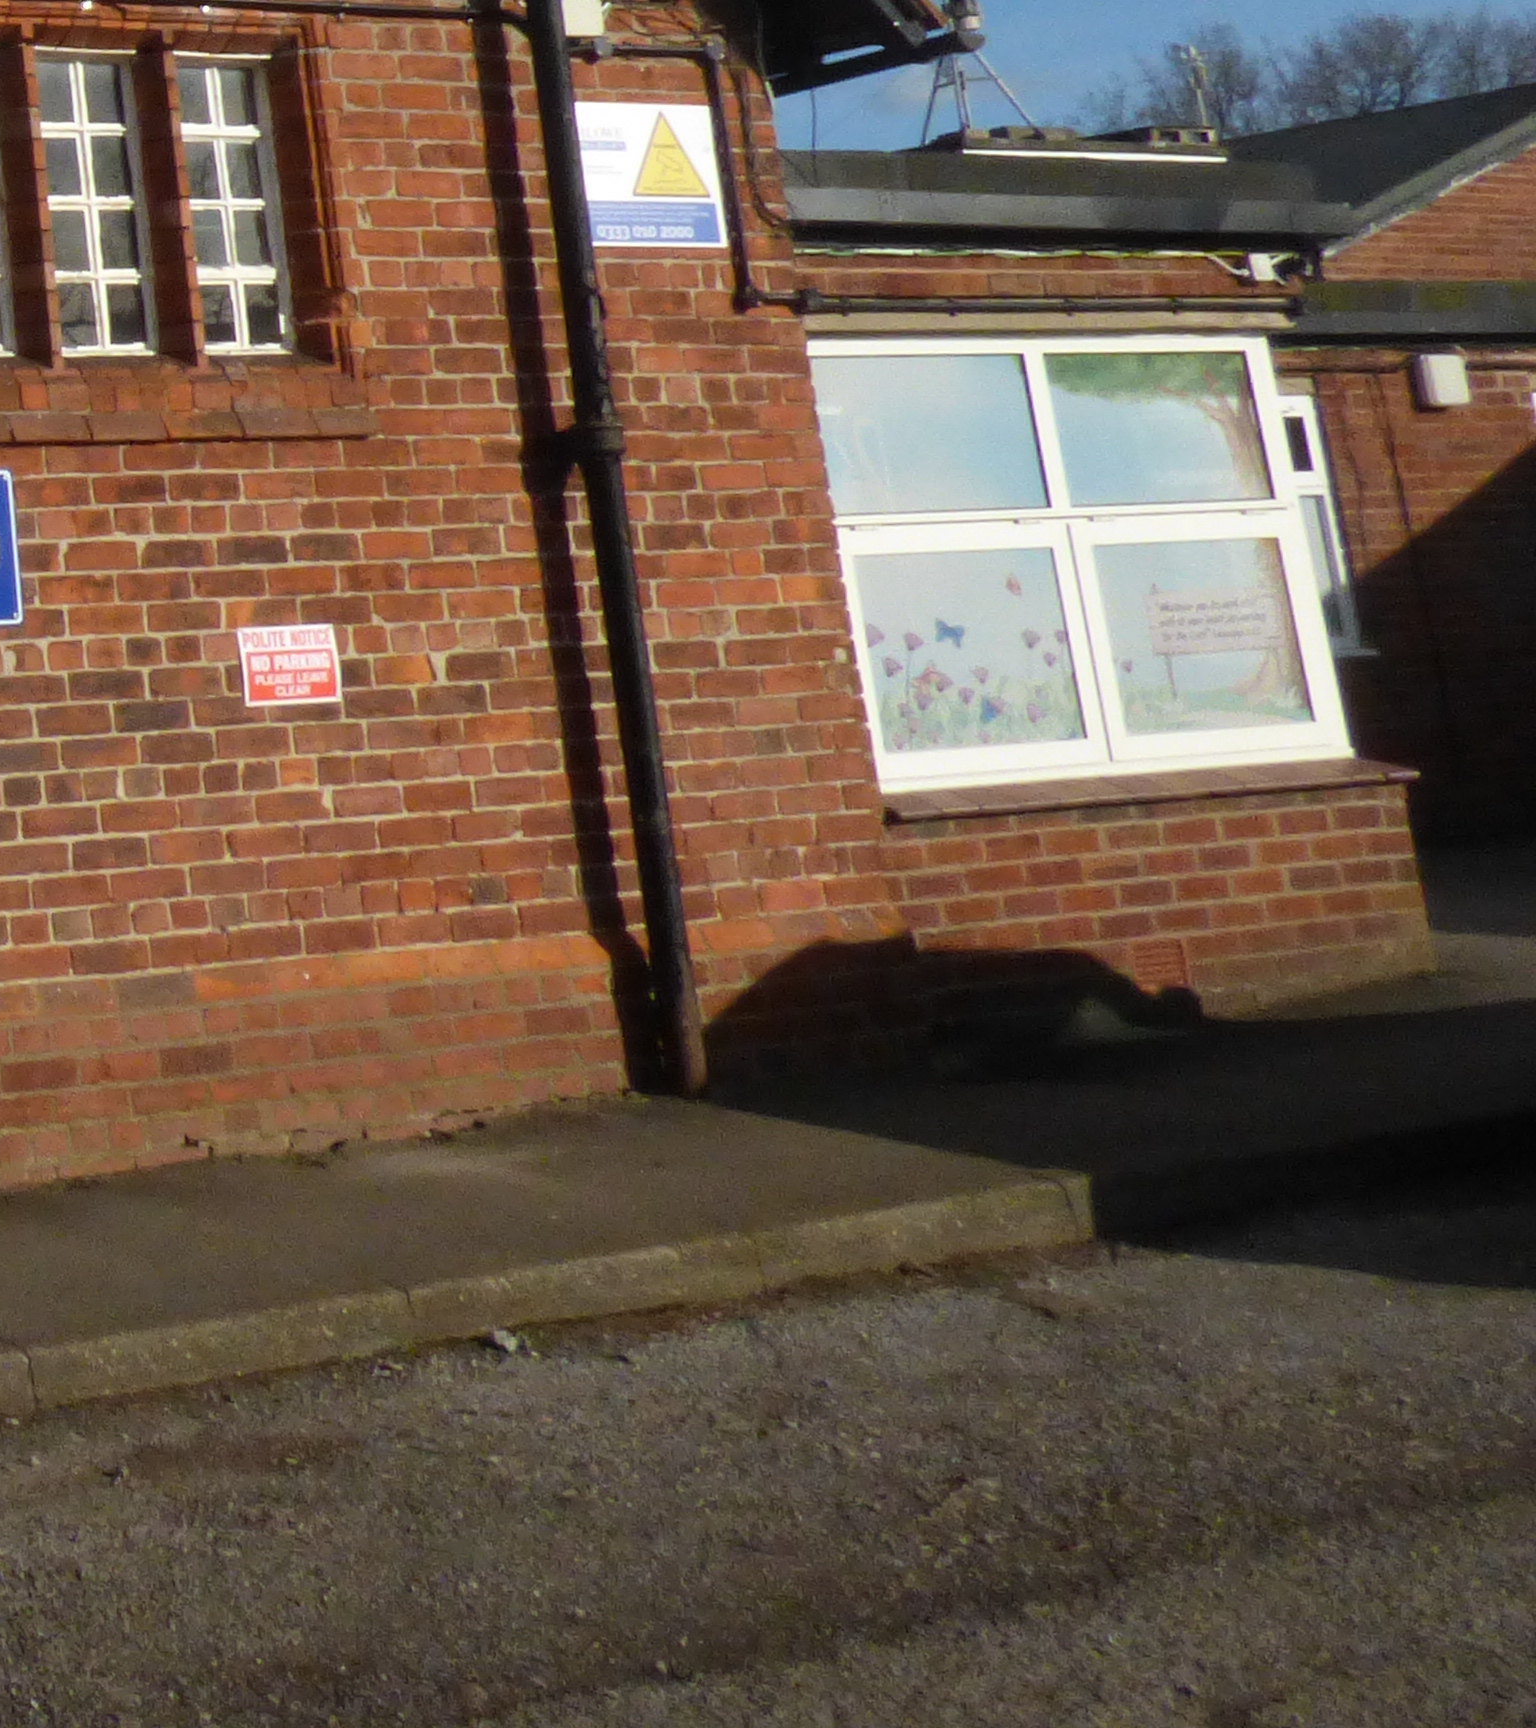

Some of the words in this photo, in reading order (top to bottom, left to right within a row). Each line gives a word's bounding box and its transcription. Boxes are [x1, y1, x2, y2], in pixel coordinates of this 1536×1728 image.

[242, 631, 286, 649] POLITE
[289, 628, 332, 647] NOTICE
[250, 655, 271, 672] NO
[273, 651, 331, 671] PARKING
